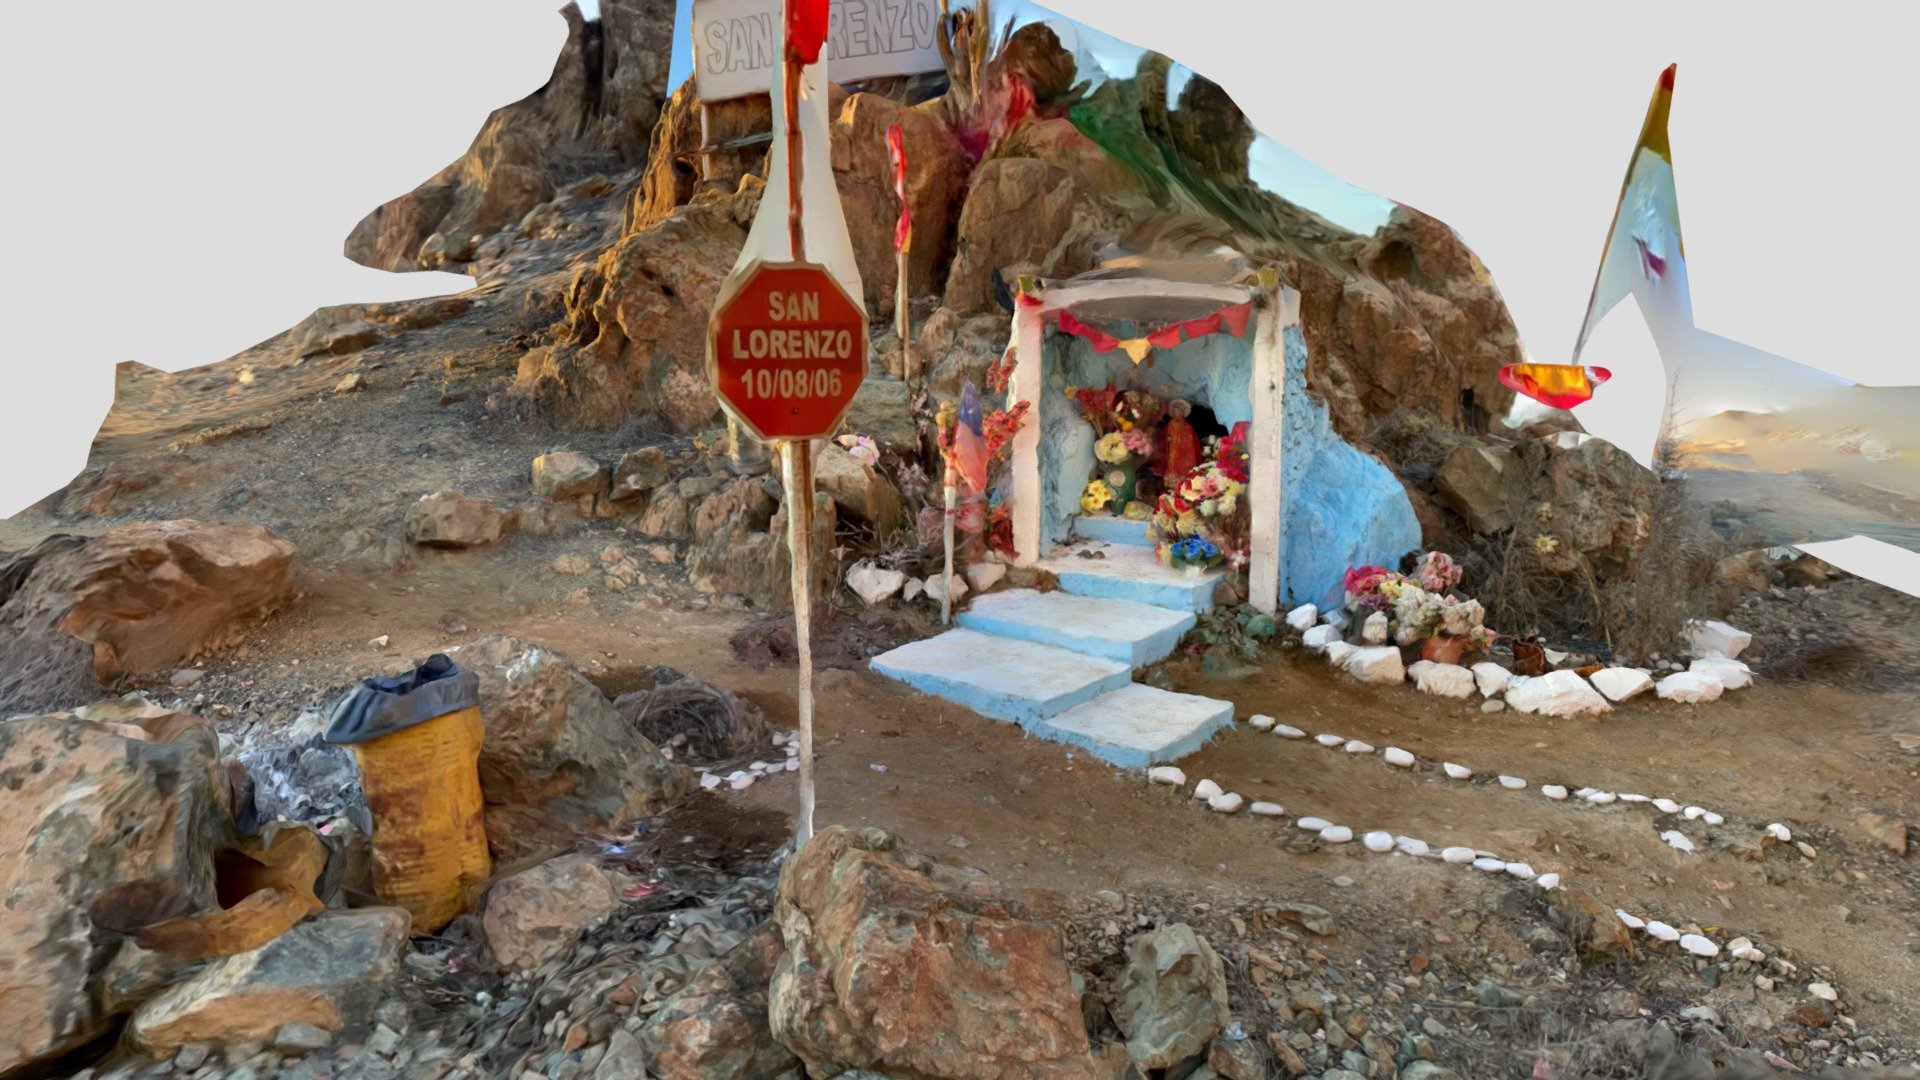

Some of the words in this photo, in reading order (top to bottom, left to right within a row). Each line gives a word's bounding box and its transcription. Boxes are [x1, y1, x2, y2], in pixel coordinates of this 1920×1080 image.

[705, 13, 773, 75] SAN
[779, 0, 937, 61] RENZO
[768, 291, 820, 321] SAN
[732, 328, 852, 360] LORENZO
[741, 368, 842, 399] 10/08/06
